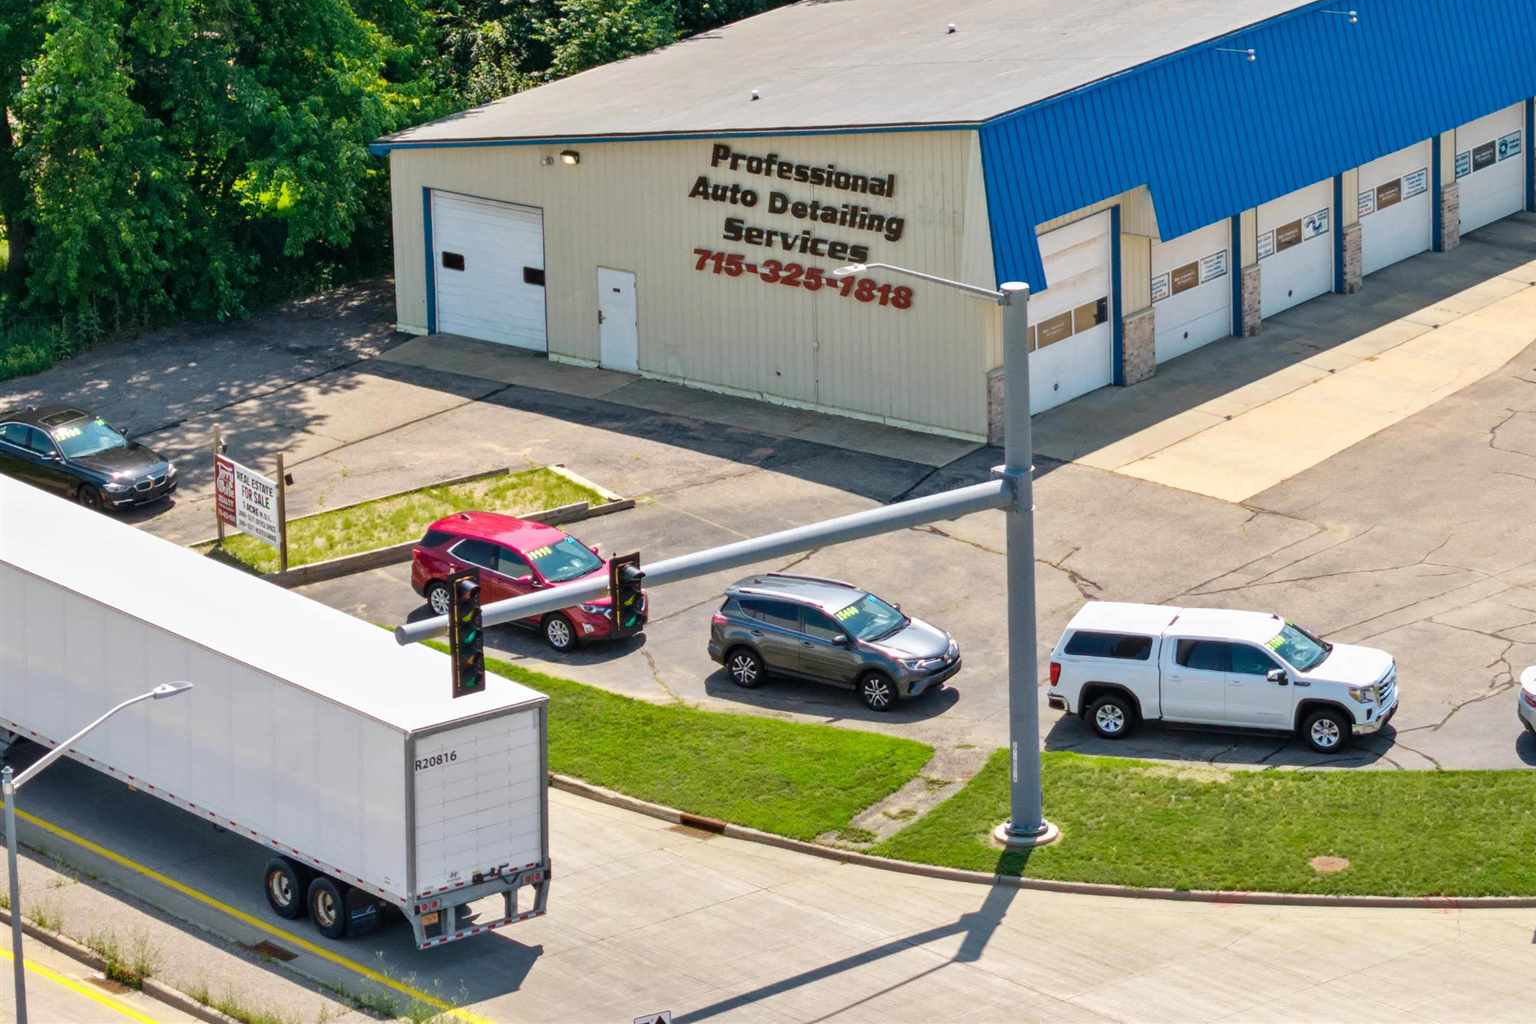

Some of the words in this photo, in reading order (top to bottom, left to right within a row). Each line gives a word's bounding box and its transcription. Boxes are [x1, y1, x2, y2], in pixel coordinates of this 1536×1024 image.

[710, 143, 896, 198] Professional
[688, 176, 758, 208] Auto
[768, 191, 905, 242] Detailing
[723, 217, 869, 263] Services
[693, 248, 913, 310] 715-325-1818
[241, 485, 253, 502] FOR
[253, 492, 271, 510] SALE
[251, 479, 273, 497] ESTATE
[415, 750, 457, 771] R20816
